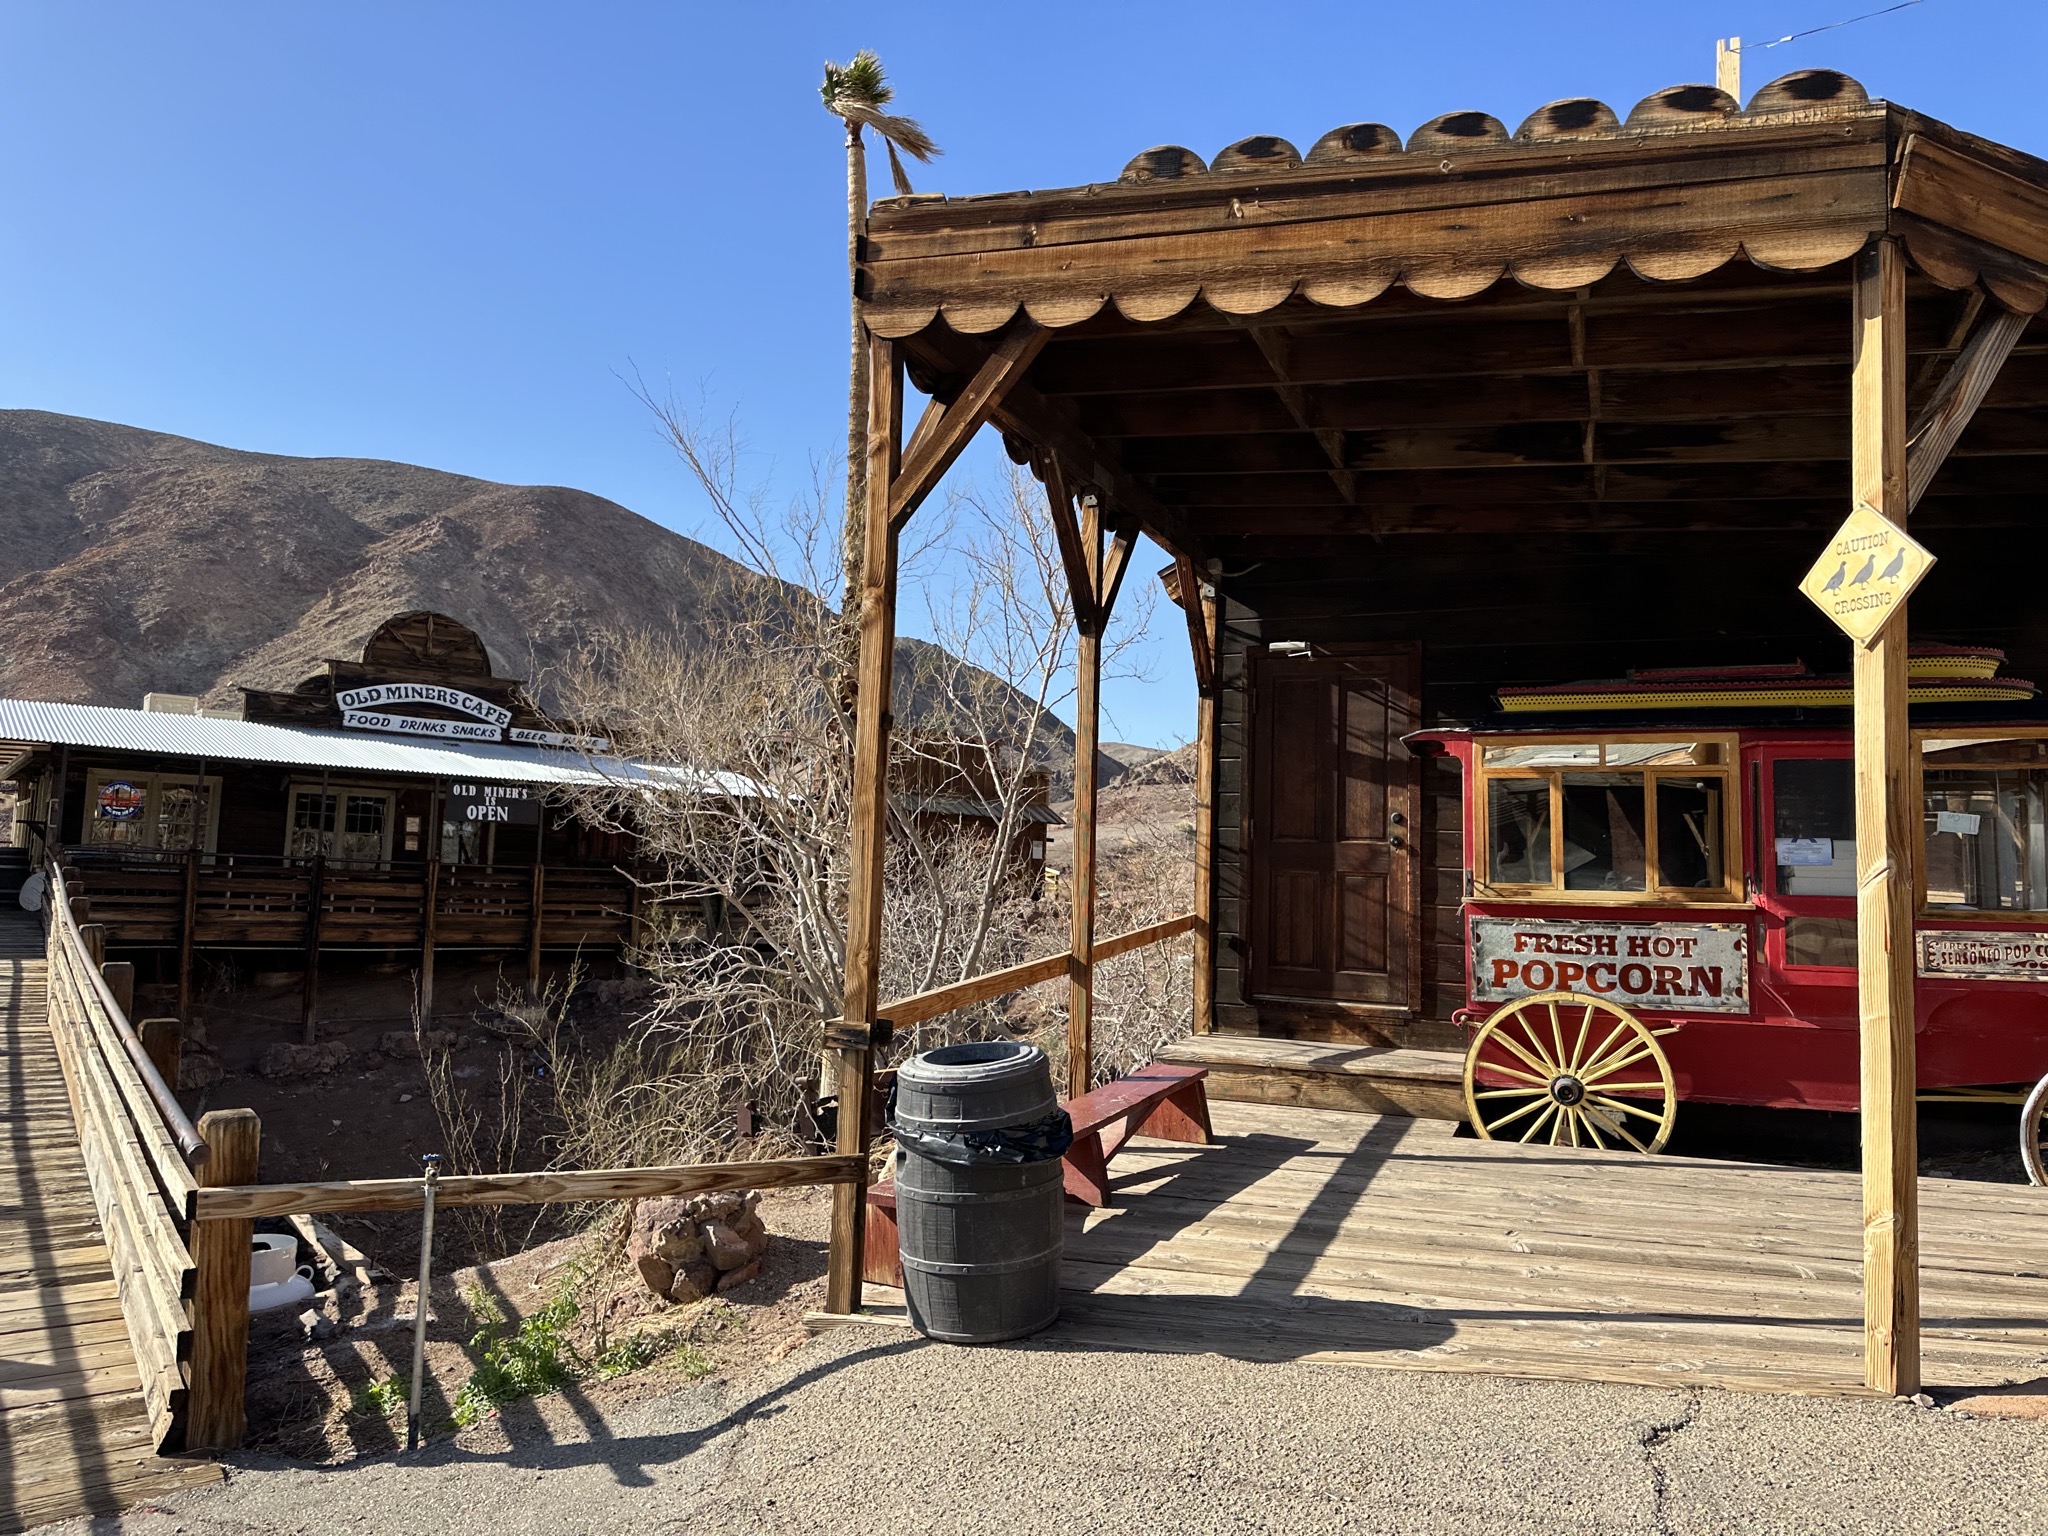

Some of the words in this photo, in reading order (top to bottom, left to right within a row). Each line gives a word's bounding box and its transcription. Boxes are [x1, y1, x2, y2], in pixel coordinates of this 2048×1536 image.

[1836, 531, 1889, 556] CAUTION
[1834, 592, 1892, 615] CROSSING
[342, 688, 382, 708] OLD
[386, 686, 459, 705] MINERS
[462, 697, 508, 725] CAFE
[348, 714, 390, 728] FOOD
[400, 719, 447, 733] DRINKS
[452, 724, 497, 738] SNACKS
[516, 731, 547, 743] BEER
[562, 735, 598, 747] WE
[453, 784, 477, 796] OLD
[484, 786, 528, 799] MINER'S
[485, 796, 496, 806] IS
[466, 805, 509, 822] OPEN
[1514, 932, 1618, 956] FRESH
[1627, 935, 1697, 958] HOT
[1941, 948, 2000, 965] SEASONED
[2004, 944, 2031, 960] POP
[1943, 942, 1976, 950] FRESH
[1491, 959, 1723, 997] POPCORN
